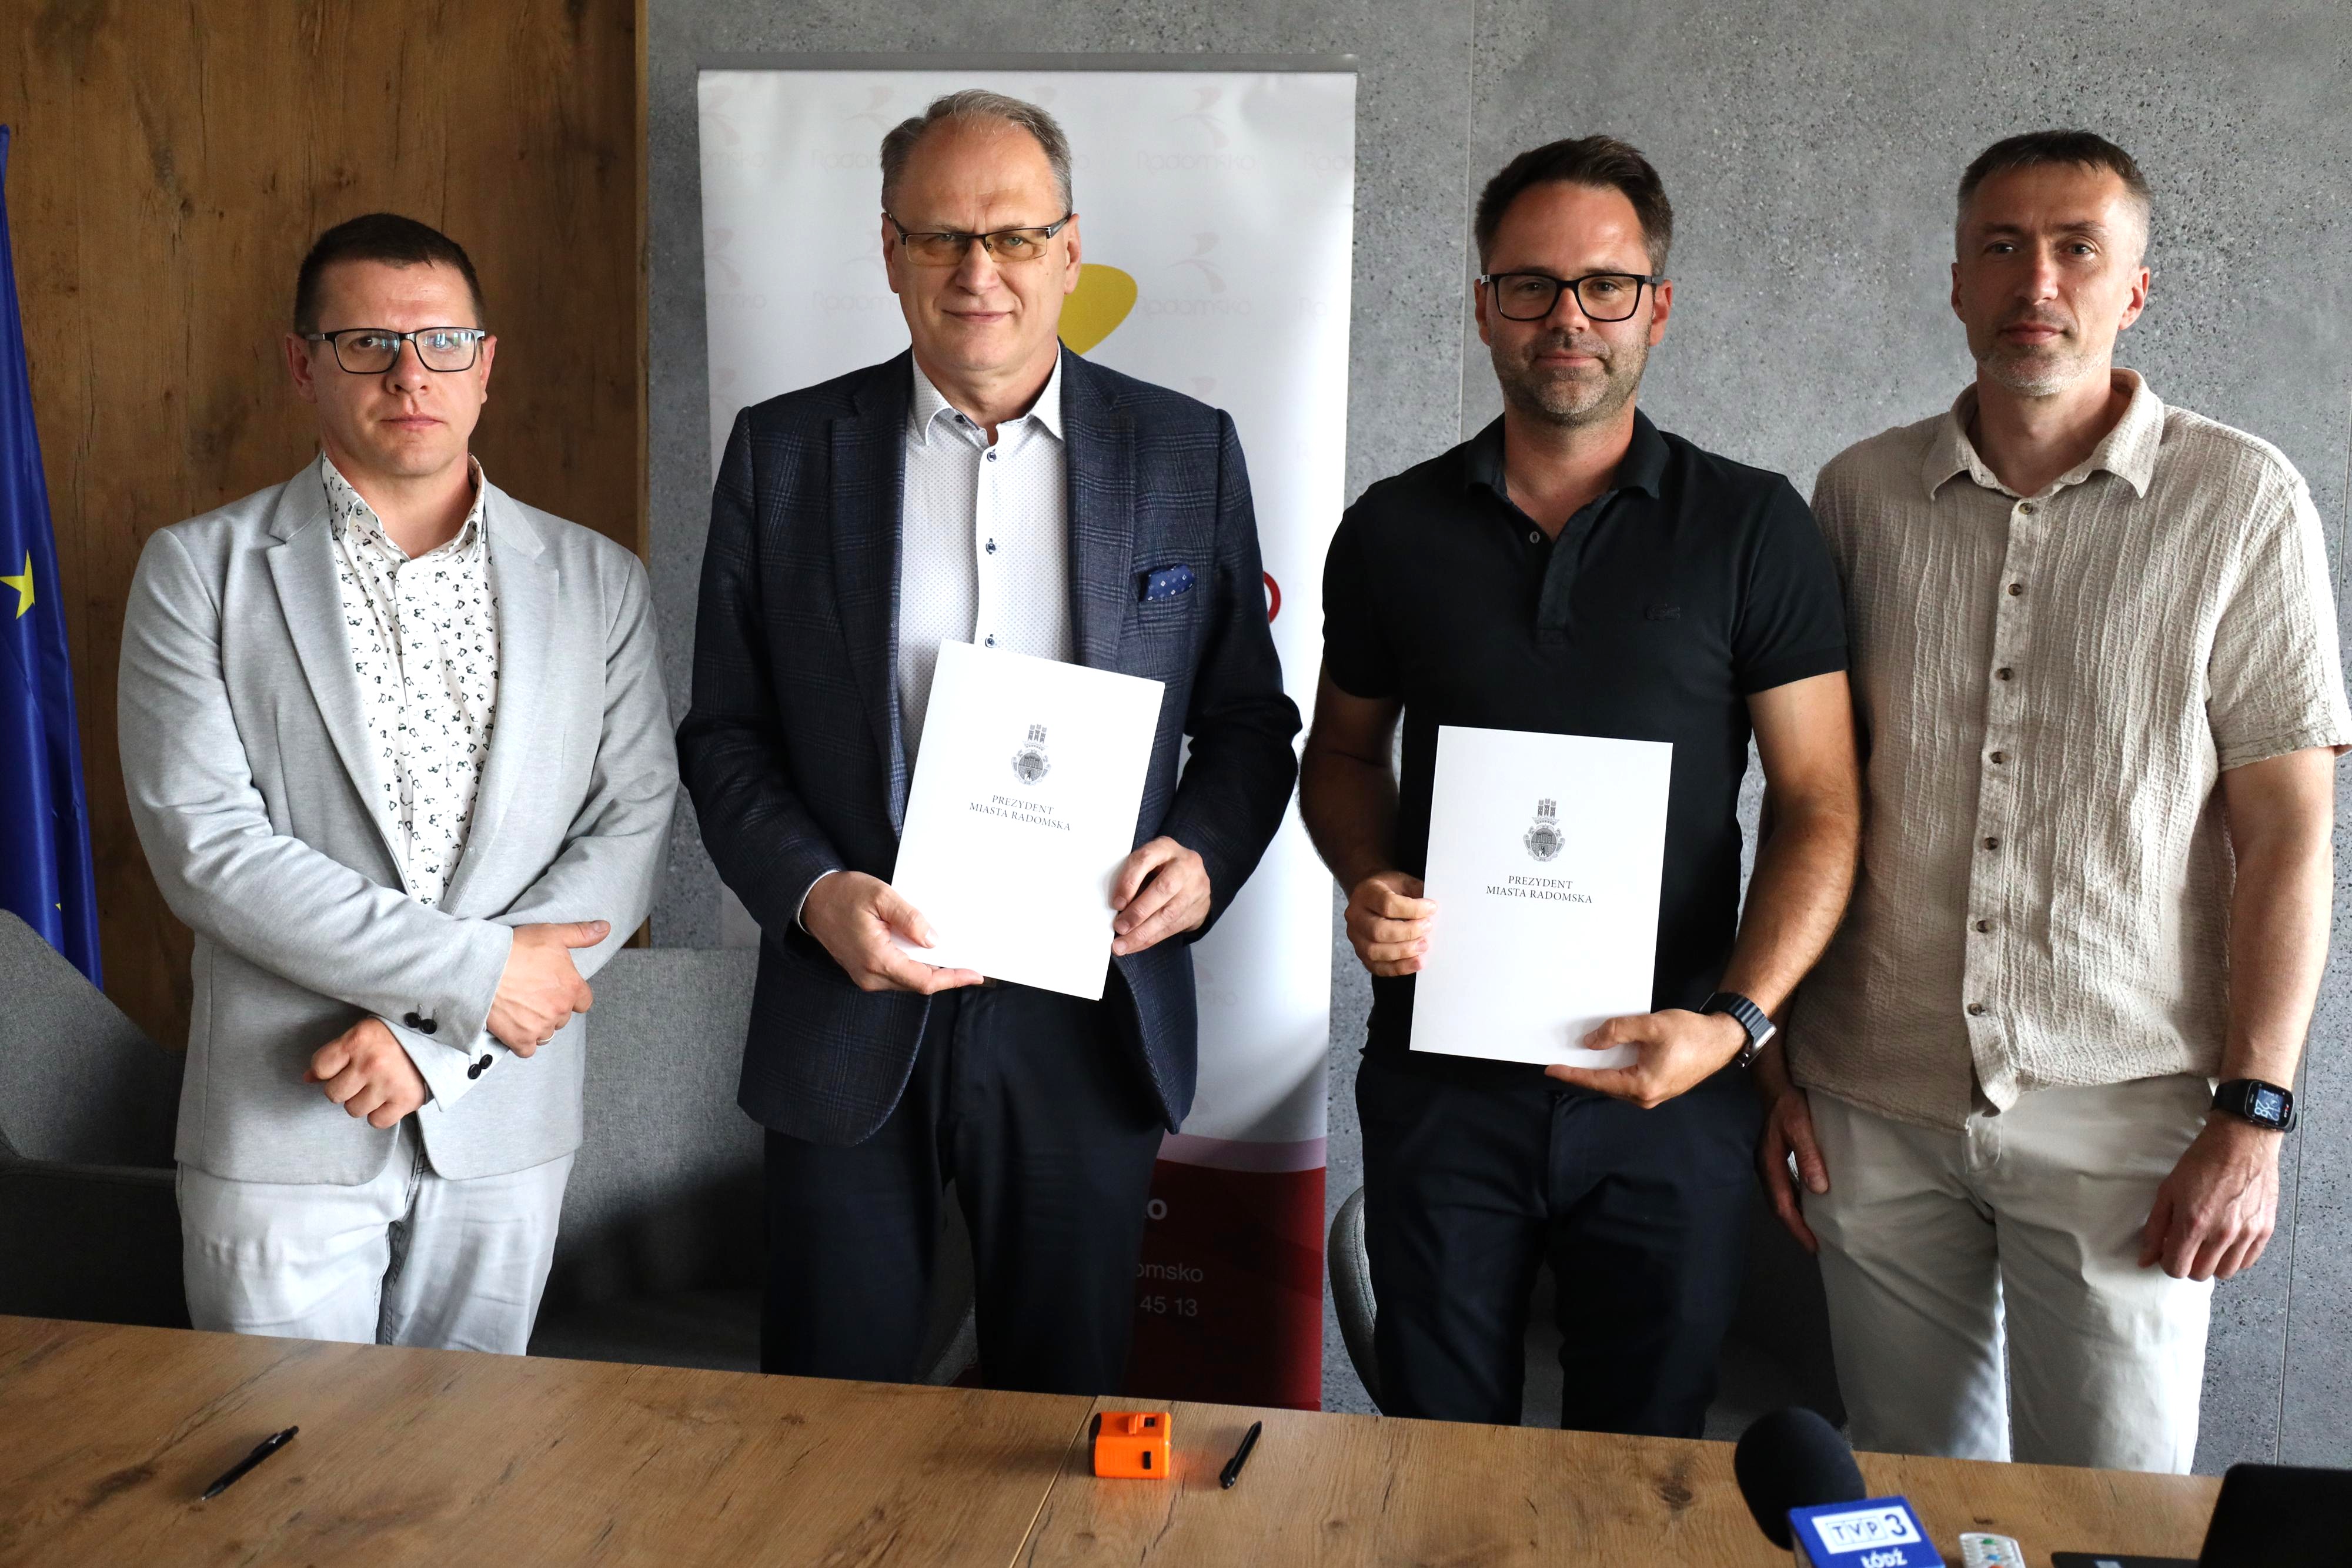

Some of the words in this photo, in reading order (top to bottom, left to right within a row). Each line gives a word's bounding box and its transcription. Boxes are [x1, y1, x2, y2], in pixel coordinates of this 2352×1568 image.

[1137, 150, 1256, 175] Radomsko
[992, 795, 1054, 814] PREZYDENT
[970, 803, 1007, 818] MIASTA
[1011, 811, 1070, 831] RADOMSKA
[1508, 875, 1573, 889] PREZYDENT
[1486, 886, 1526, 897] MIASTA
[1530, 890, 1592, 904] RADOMSKA
[1140, 1295, 1167, 1313] 45
[1175, 1298, 1198, 1316] 13
